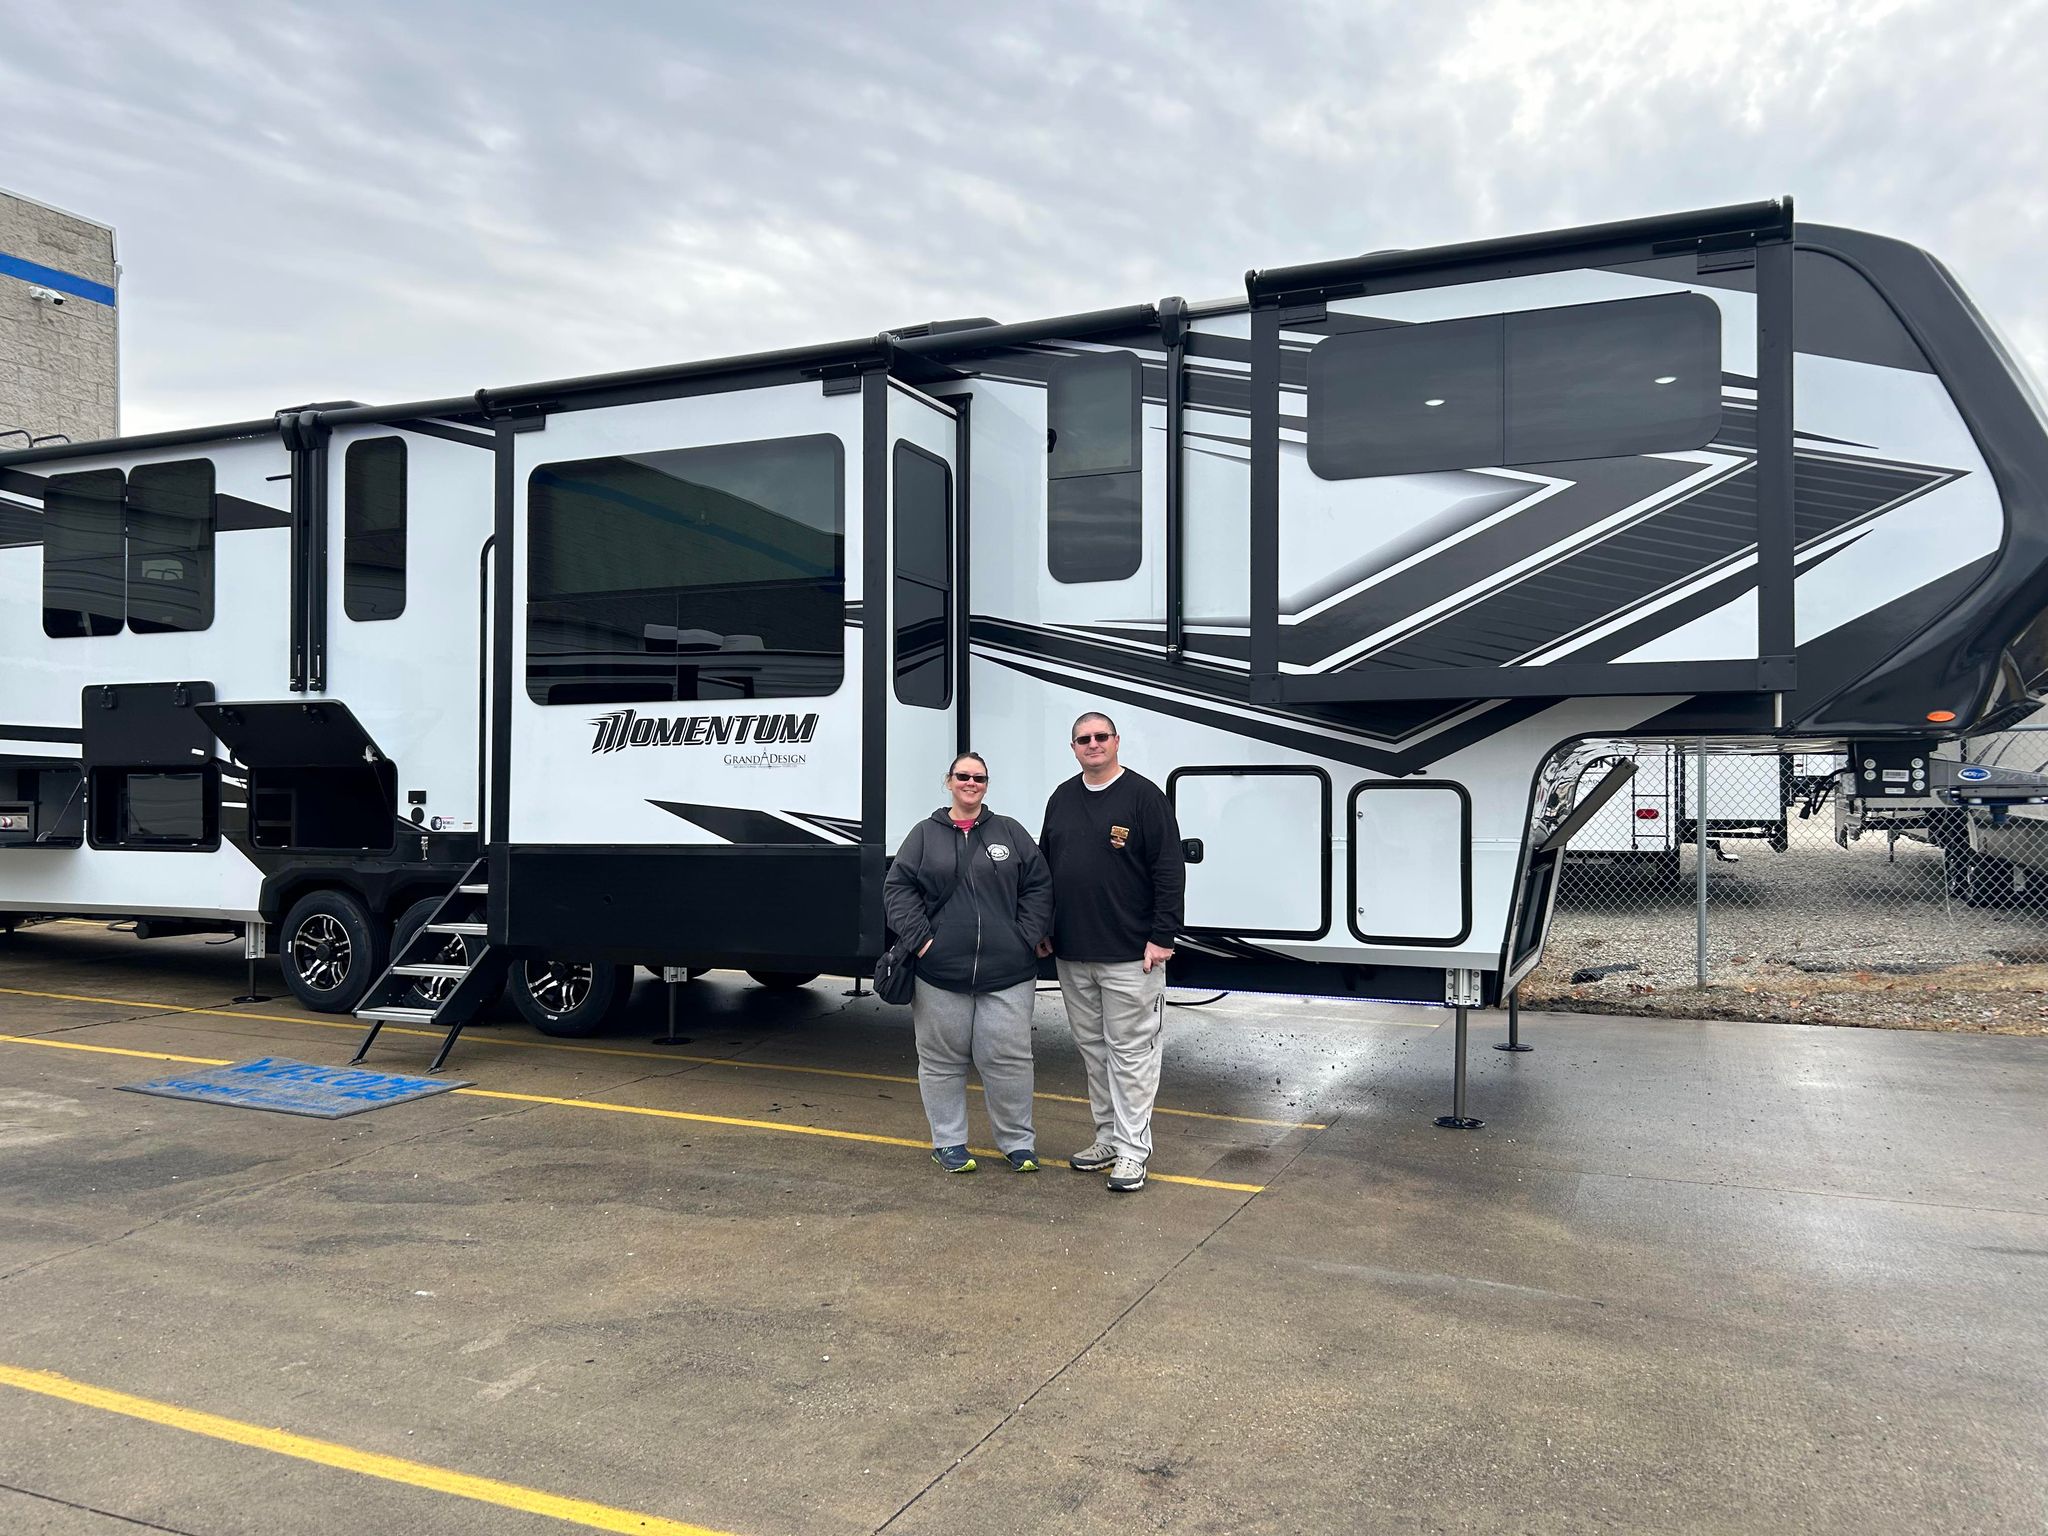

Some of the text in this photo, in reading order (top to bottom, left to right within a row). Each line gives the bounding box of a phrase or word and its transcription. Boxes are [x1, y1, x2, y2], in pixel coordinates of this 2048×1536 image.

[586, 709, 819, 754] MOMENTUM
[723, 753, 806, 764] GRAND DESIGN
